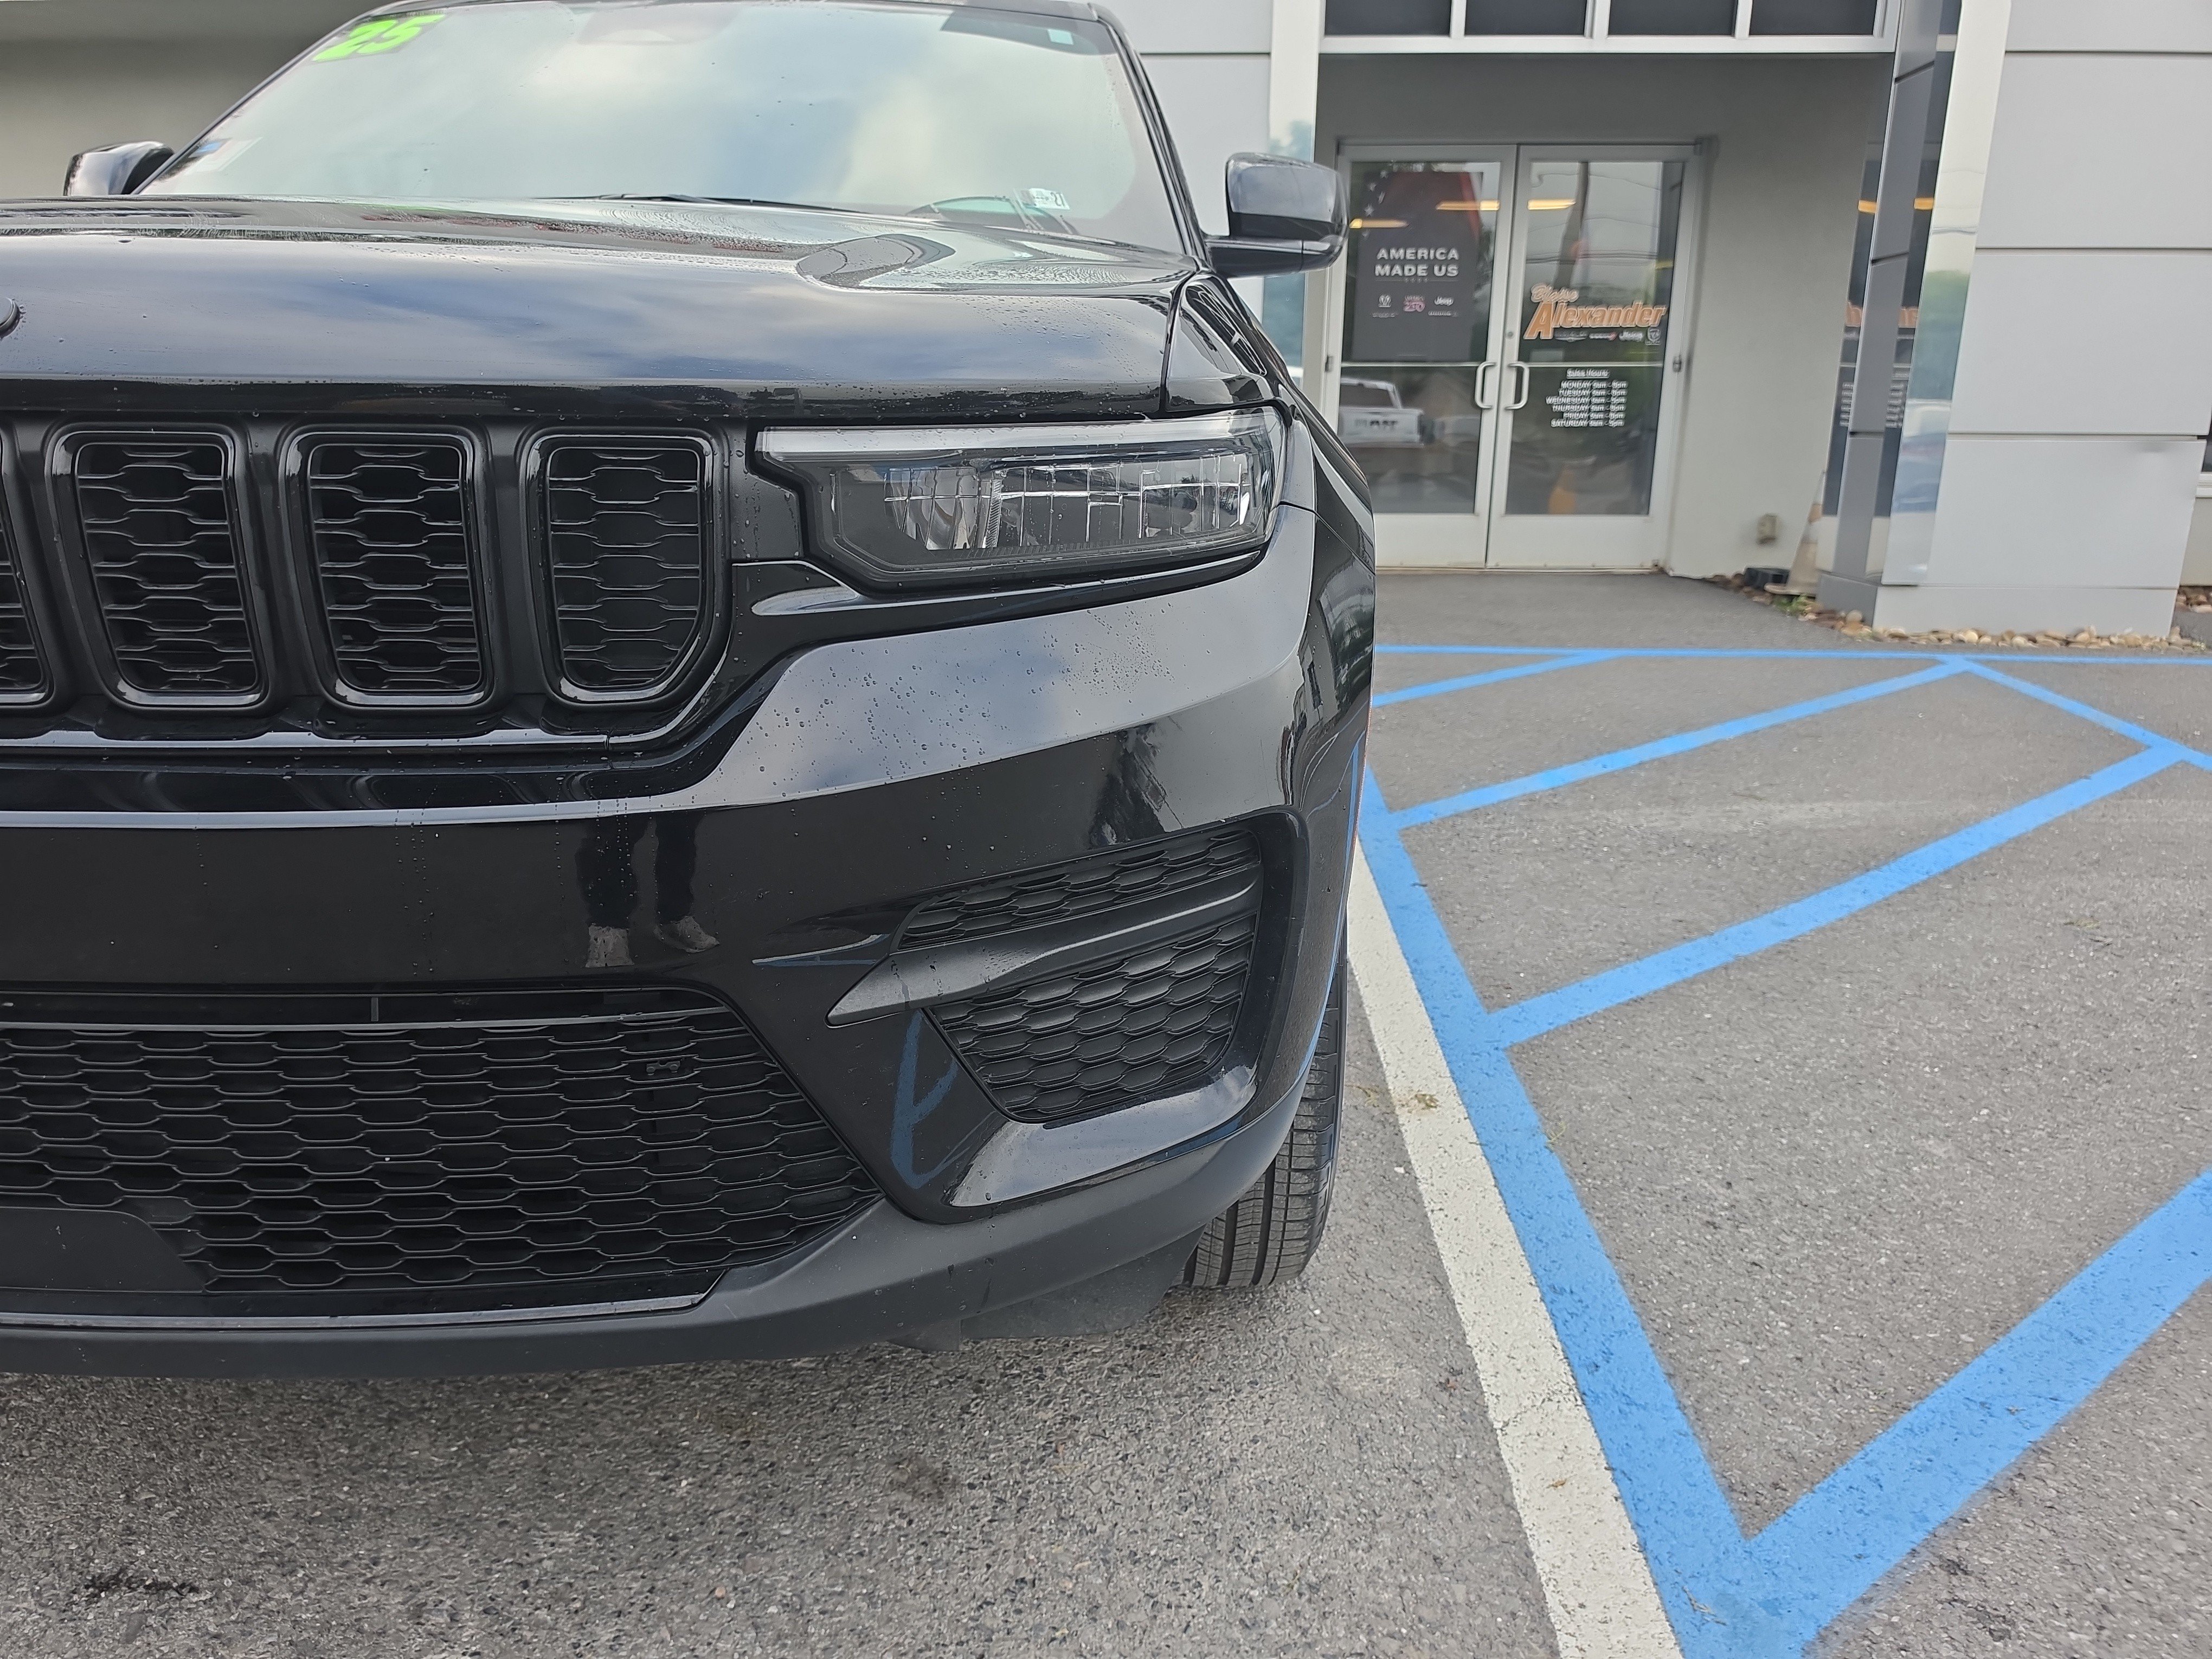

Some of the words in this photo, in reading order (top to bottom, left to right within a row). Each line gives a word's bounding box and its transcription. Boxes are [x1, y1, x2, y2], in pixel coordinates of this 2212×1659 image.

[311, 14, 446, 63] 25
[1377, 247, 1459, 260] AMERICA
[1375, 263, 1429, 277] MADE
[1433, 263, 1459, 277] US
[1523, 299, 1668, 340] Alexander
